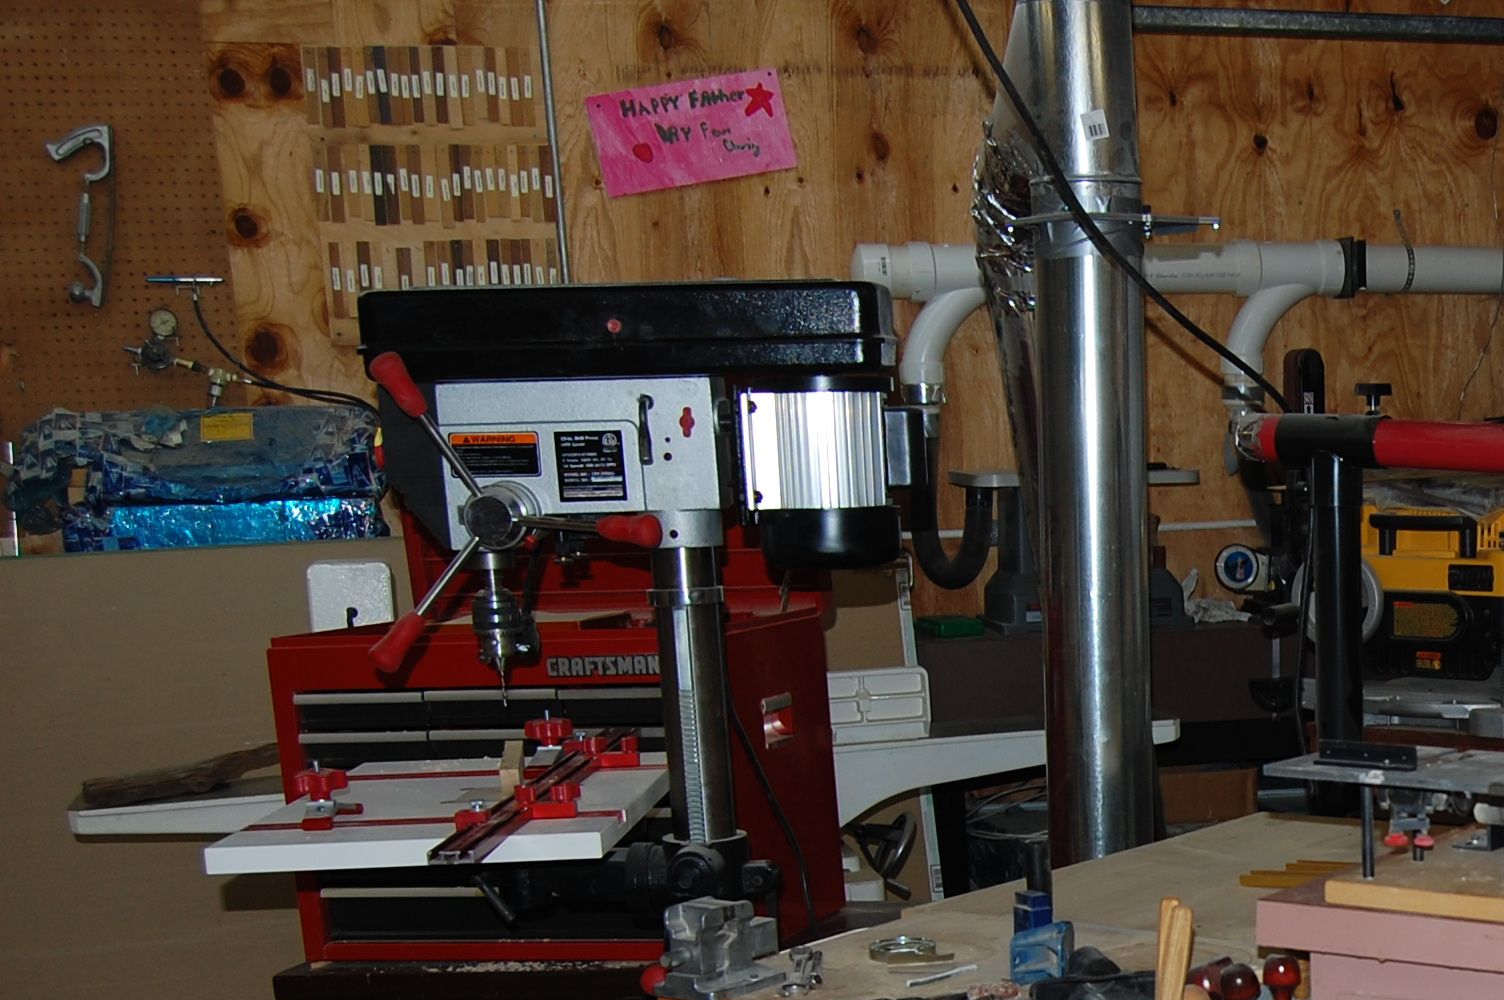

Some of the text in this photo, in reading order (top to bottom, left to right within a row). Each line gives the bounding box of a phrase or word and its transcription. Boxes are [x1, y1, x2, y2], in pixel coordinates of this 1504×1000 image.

[619, 93, 680, 118] HAPPY
[471, 435, 516, 443] WARNING
[546, 656, 660, 677] CRAFTSMAN
